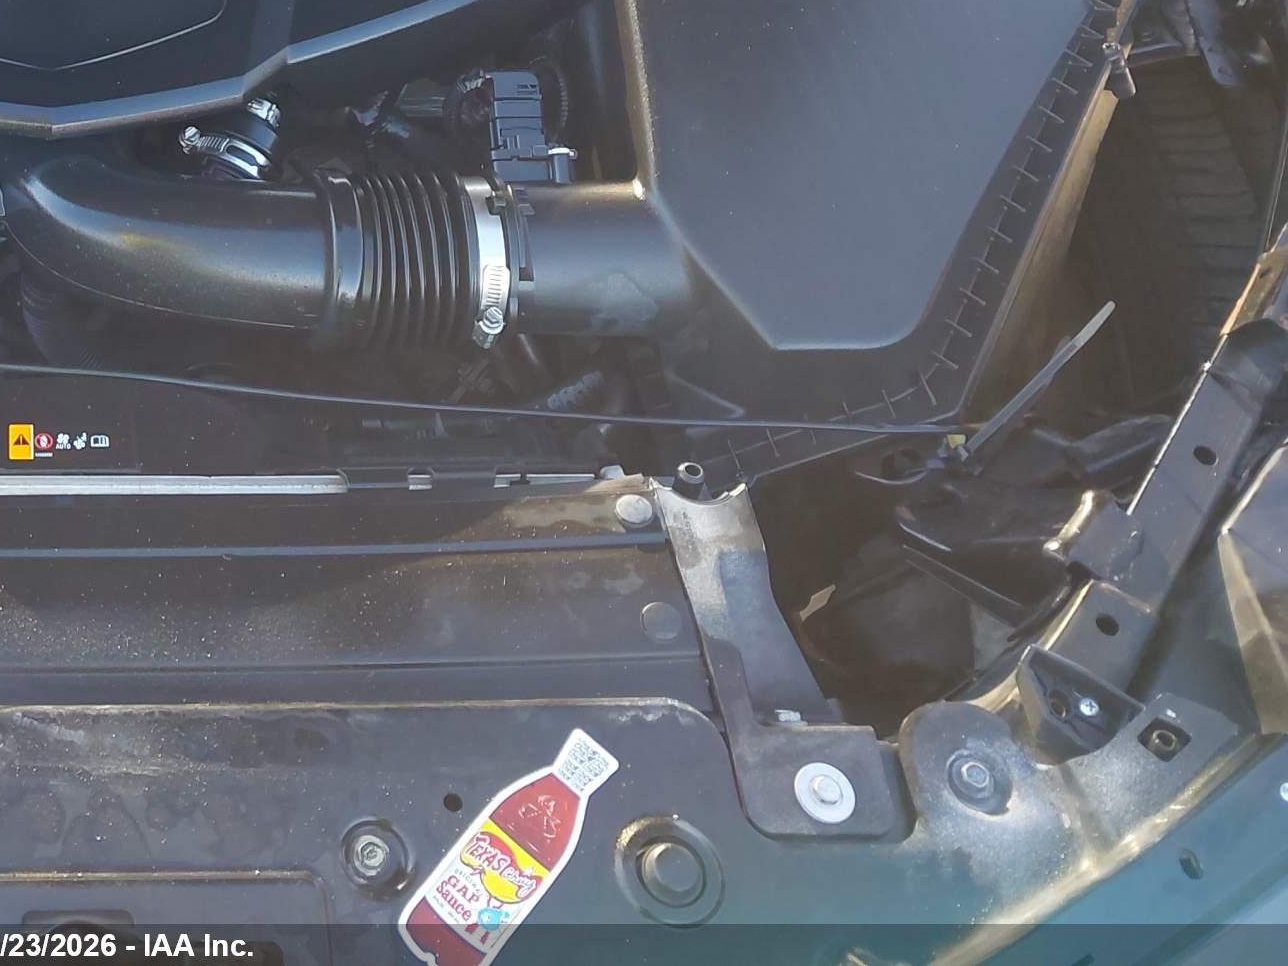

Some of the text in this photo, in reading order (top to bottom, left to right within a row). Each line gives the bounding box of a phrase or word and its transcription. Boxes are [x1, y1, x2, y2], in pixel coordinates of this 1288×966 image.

[467, 836, 508, 871] TEXAS
[436, 880, 472, 921] Sauce
[448, 875, 480, 904] GAP
